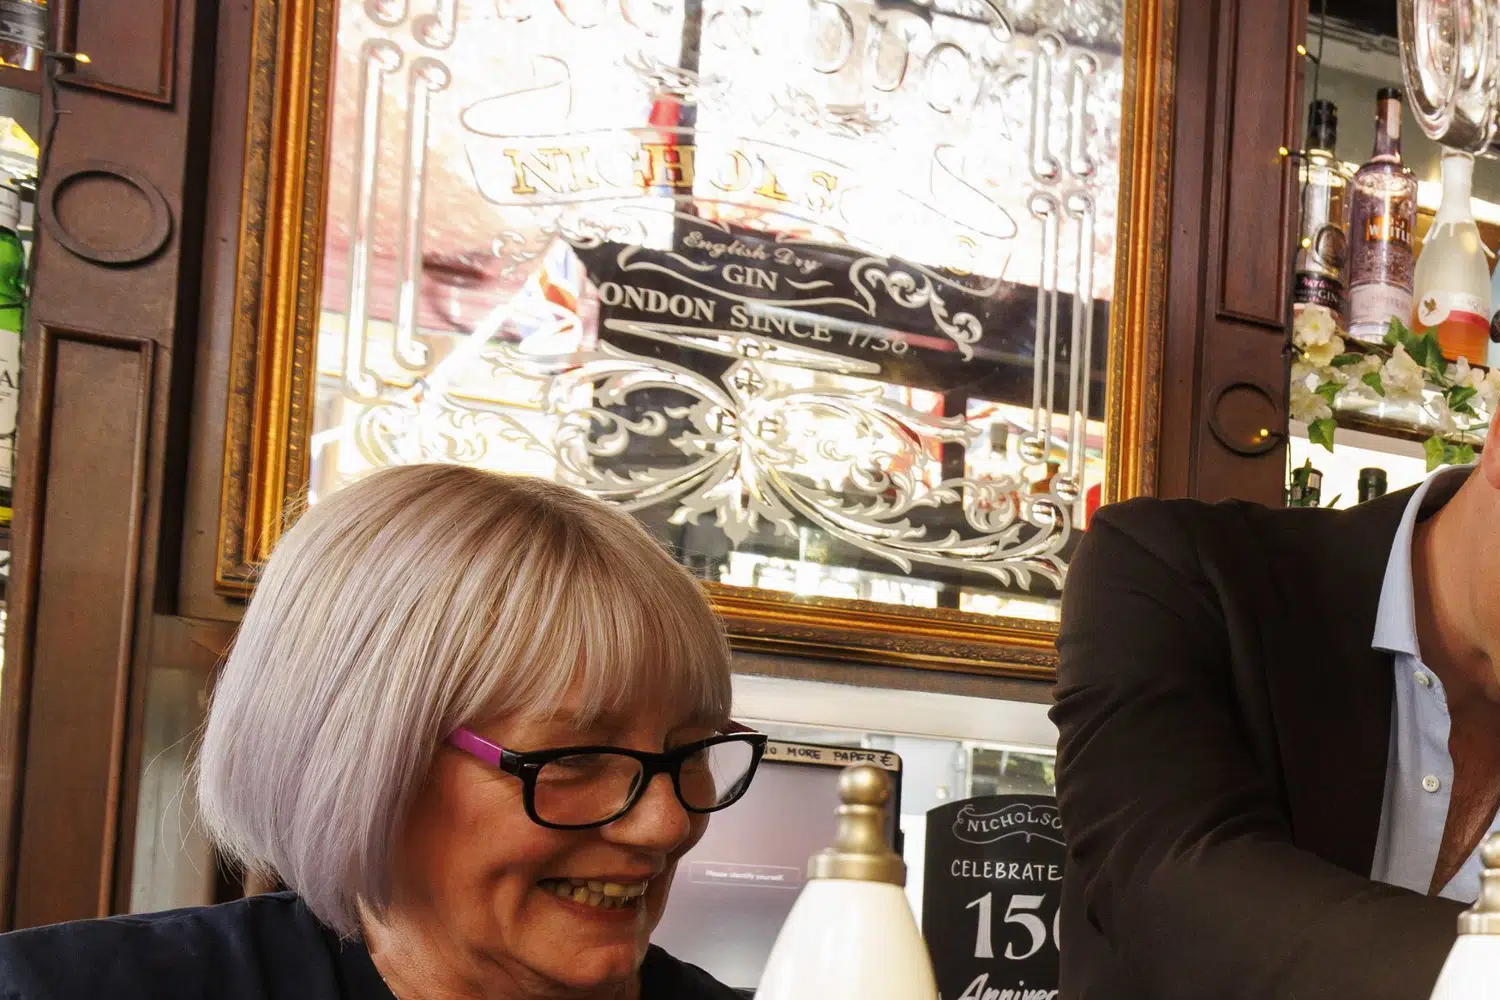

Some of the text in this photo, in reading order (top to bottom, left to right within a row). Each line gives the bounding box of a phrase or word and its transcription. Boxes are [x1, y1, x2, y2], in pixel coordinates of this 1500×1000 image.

[683, 229, 823, 273] English Dry
[721, 264, 779, 292] GIN
[1318, 289, 1338, 302] GIN
[598, 280, 717, 324] ONDON
[730, 302, 833, 342] SINCE
[787, 746, 821, 760] MORE
[833, 750, 876, 763] PAPER
[967, 811, 1063, 833] NICHOLSO
